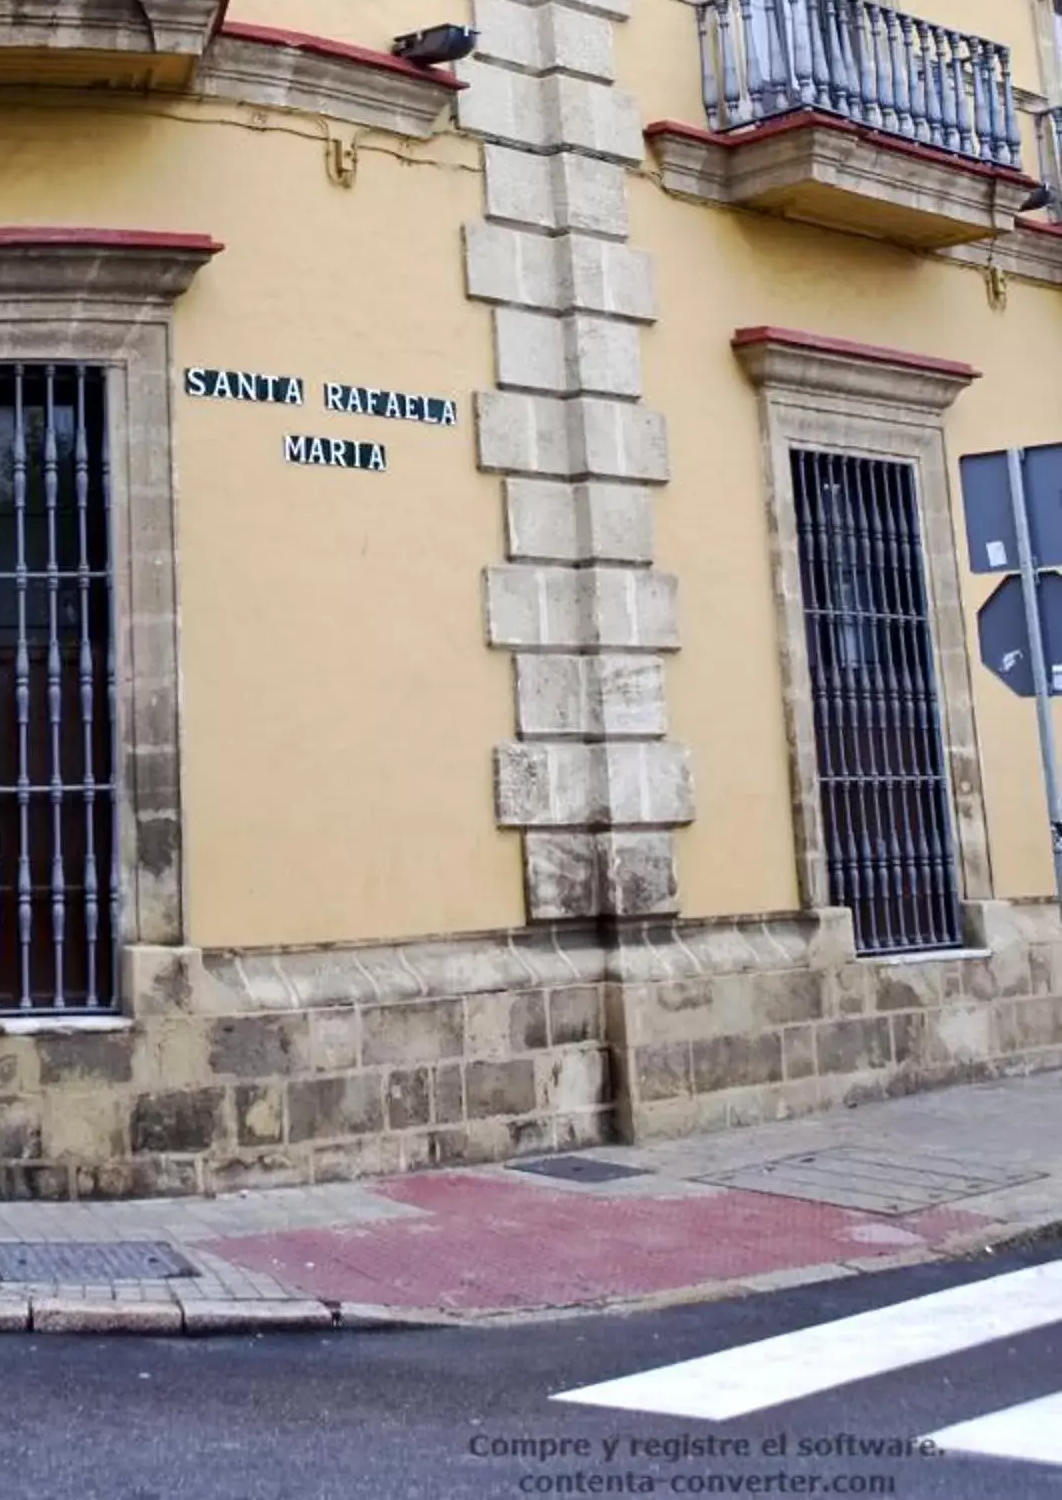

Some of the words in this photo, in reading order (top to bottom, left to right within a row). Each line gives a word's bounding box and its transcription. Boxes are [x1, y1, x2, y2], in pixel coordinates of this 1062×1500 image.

[186, 367, 304, 405] SANTA
[326, 382, 457, 426] RAFAELA
[283, 435, 387, 471] MARIA
